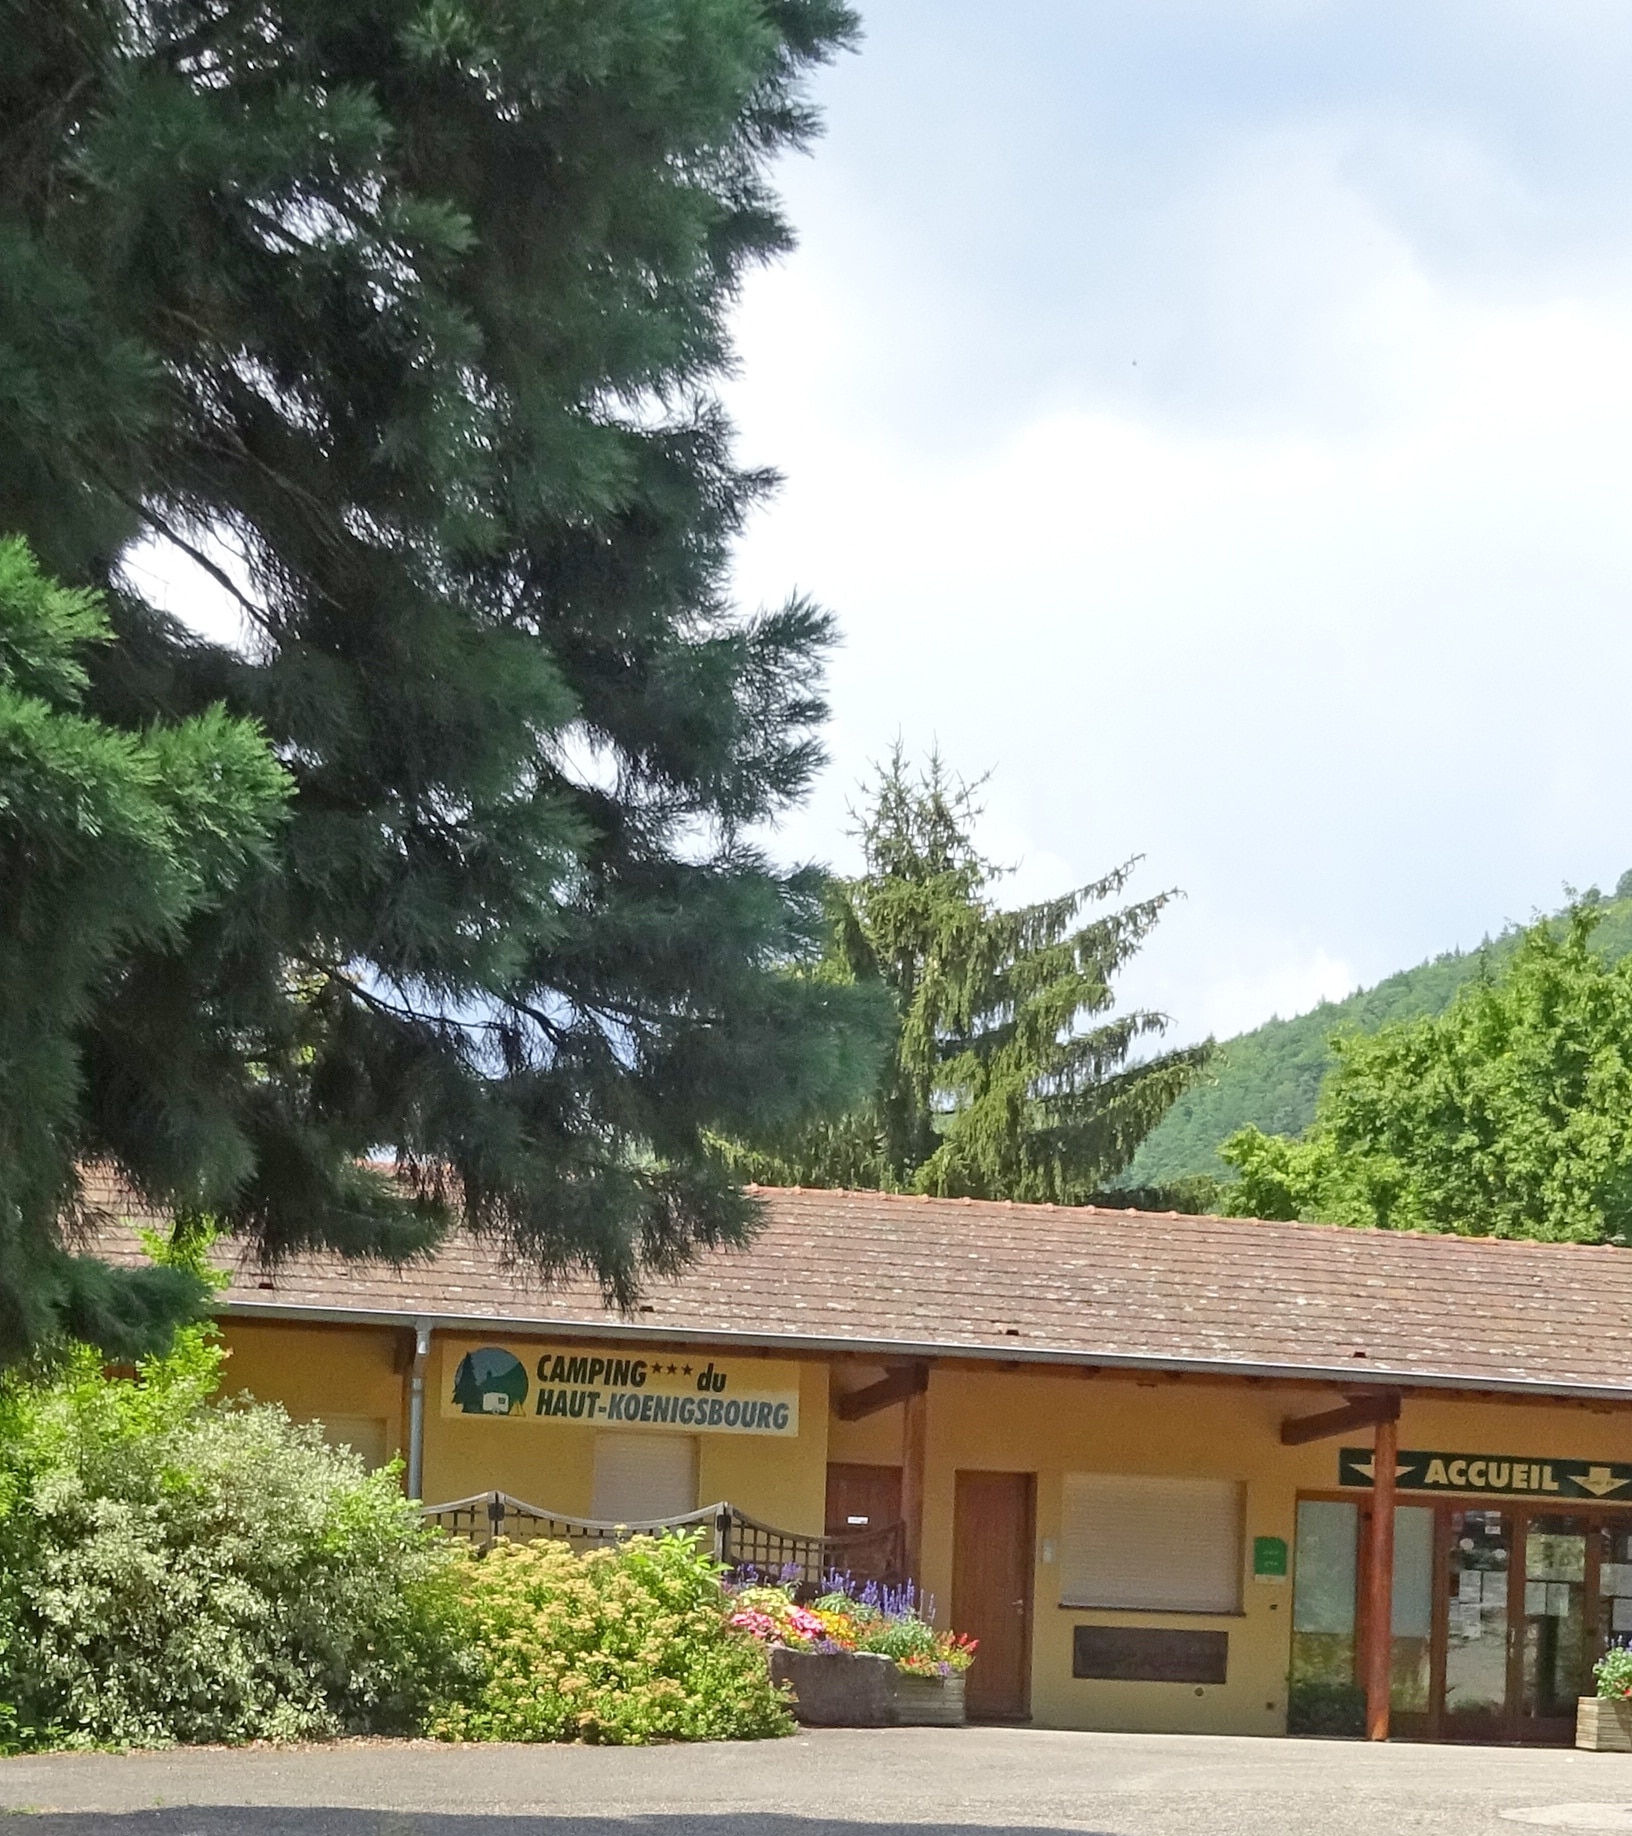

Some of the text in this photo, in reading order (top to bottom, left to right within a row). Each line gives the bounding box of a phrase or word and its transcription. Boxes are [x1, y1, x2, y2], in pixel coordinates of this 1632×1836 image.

[536, 1354, 727, 1392] CAMPING du
[536, 1389, 789, 1429] HAUT-KOENIGSBOURG
[1424, 1459, 1560, 1491] ACCUEIL
